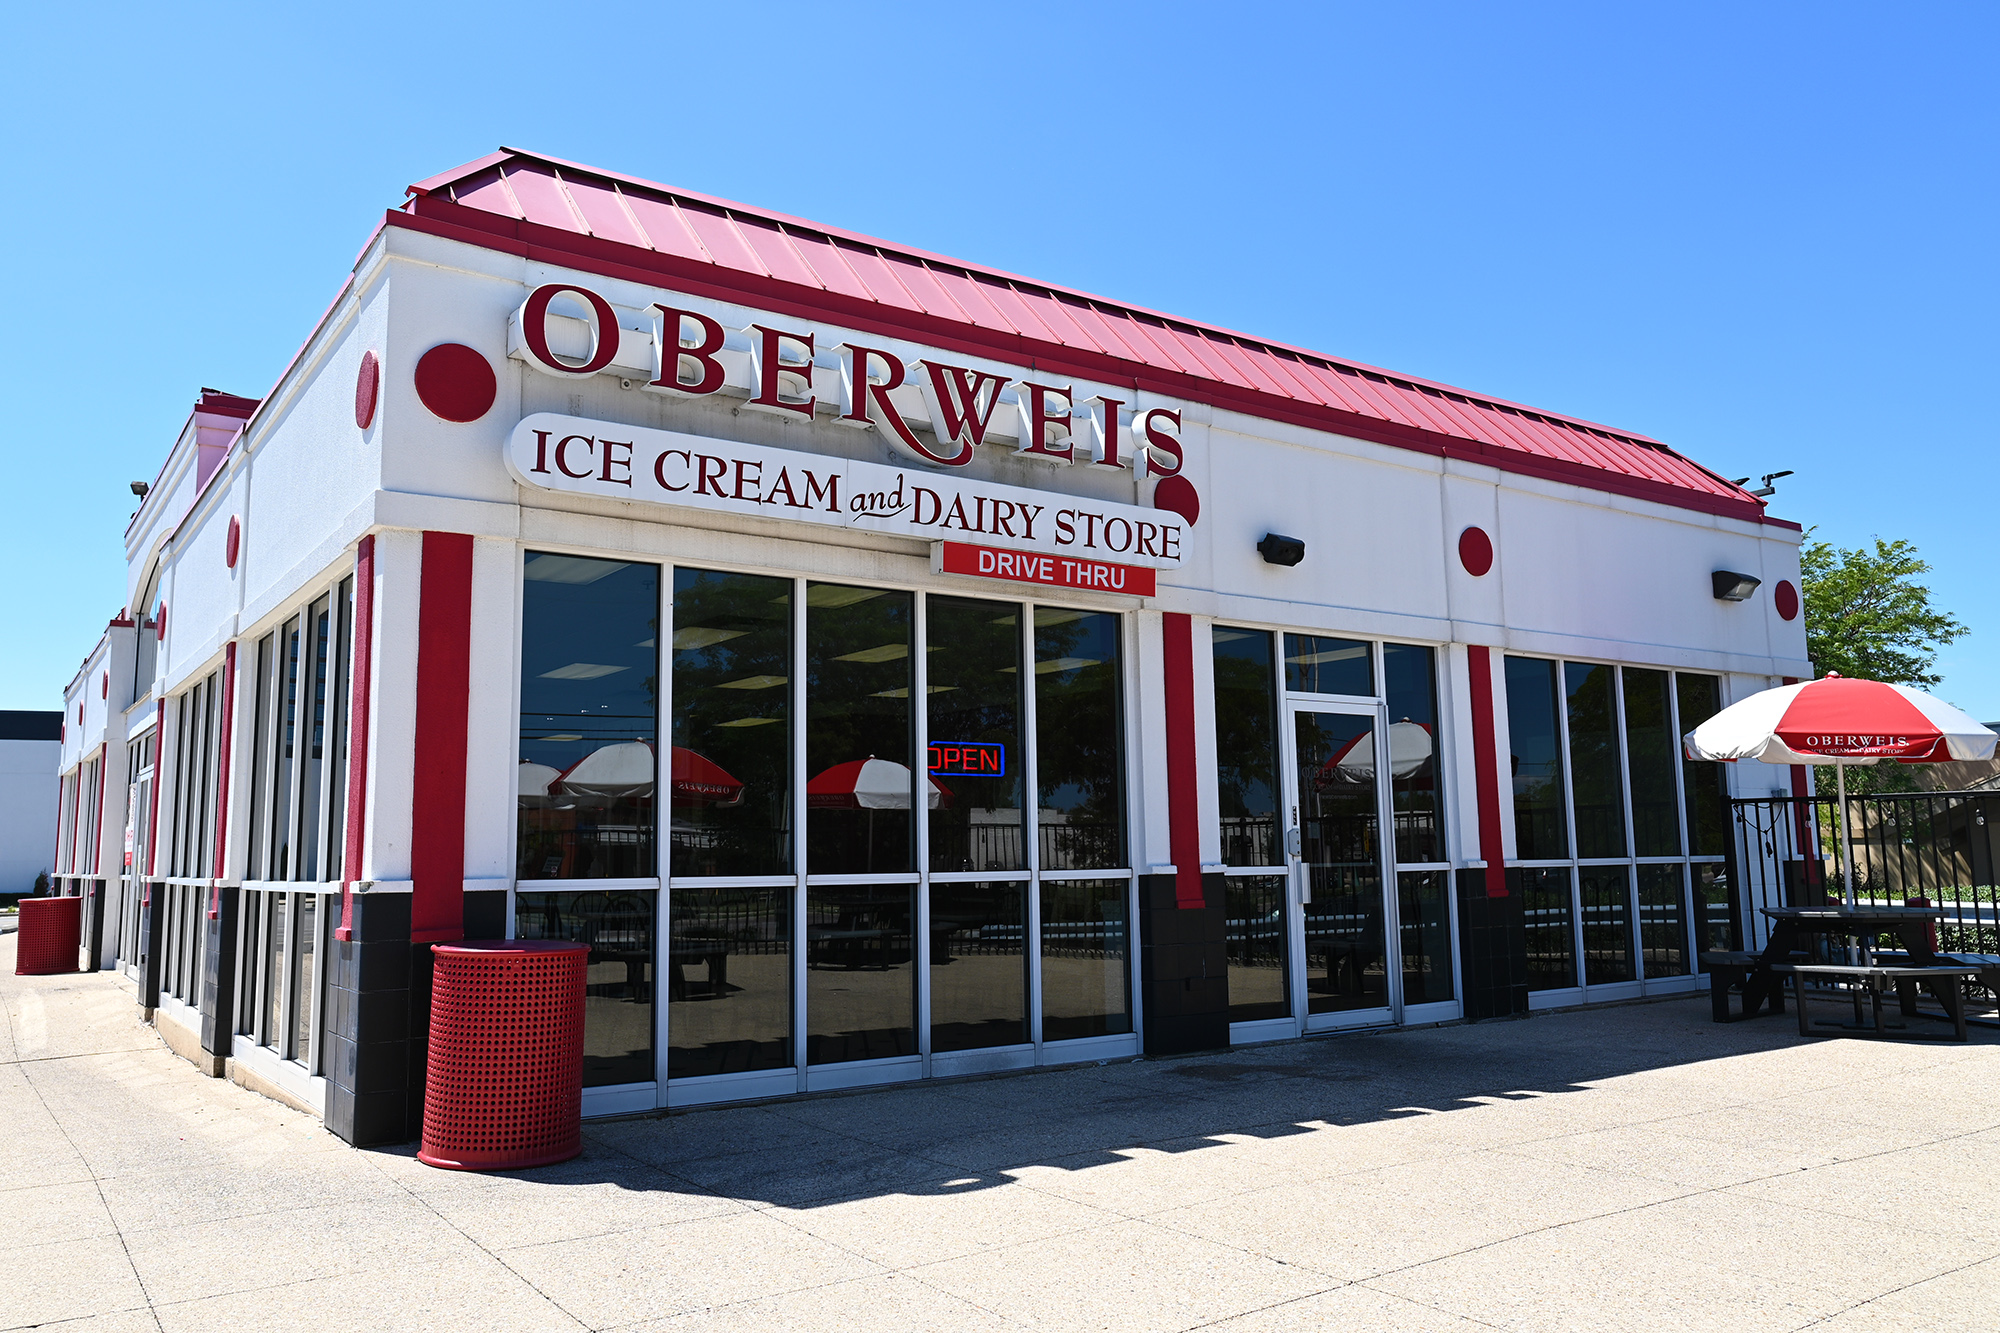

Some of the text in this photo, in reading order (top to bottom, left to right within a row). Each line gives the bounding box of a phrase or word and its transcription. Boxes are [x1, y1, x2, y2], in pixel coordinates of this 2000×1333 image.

[522, 283, 1184, 477] OBERWEIS
[530, 428, 1182, 562] ICE CREAM and DAIRY STORE
[978, 550, 1126, 589] DRIVE THRU
[927, 747, 998, 771] OPEN
[1806, 735, 1910, 747] OBERWEIS
